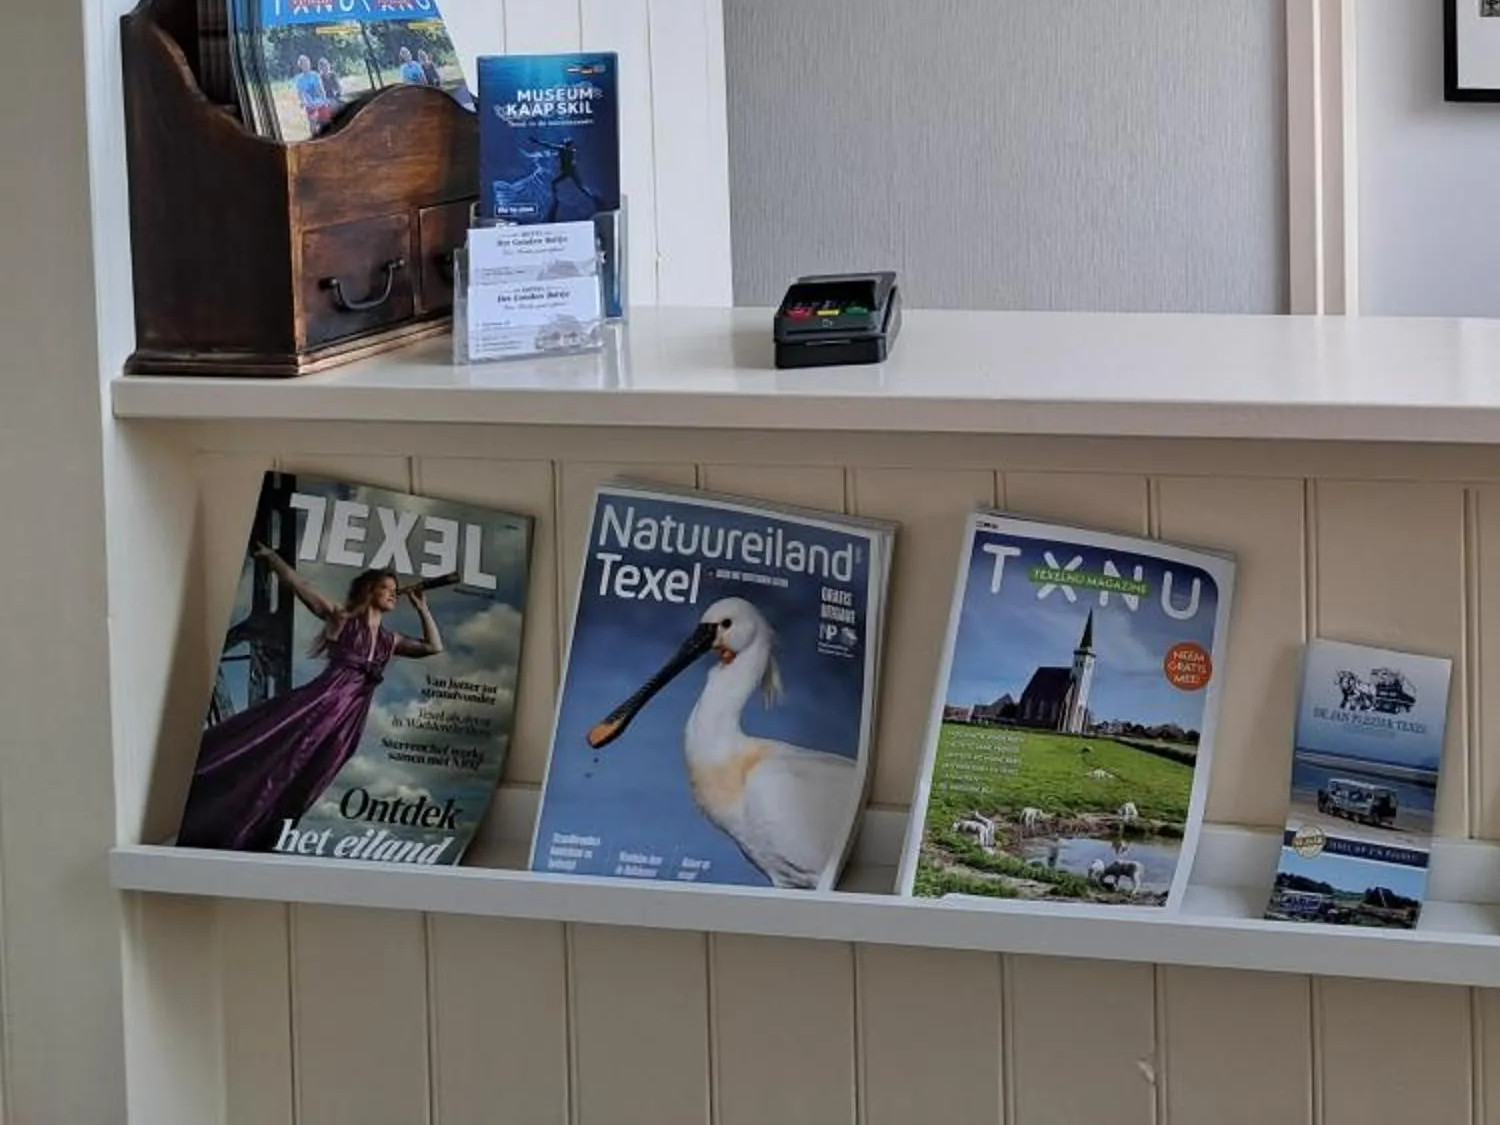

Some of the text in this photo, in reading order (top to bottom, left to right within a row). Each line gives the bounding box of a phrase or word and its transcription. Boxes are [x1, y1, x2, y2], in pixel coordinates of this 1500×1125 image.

[517, 87, 593, 103] MUSEUM
[599, 503, 855, 582] Natuureiland
[596, 552, 700, 604] Texel
[982, 544, 1202, 620] TXNU
[1087, 576, 1148, 594] MAGAZINE
[1168, 662, 1207, 674] GRATIS
[1173, 650, 1205, 662] NEEM
[340, 787, 464, 831] Ontdek
[273, 818, 457, 867] het eiland
